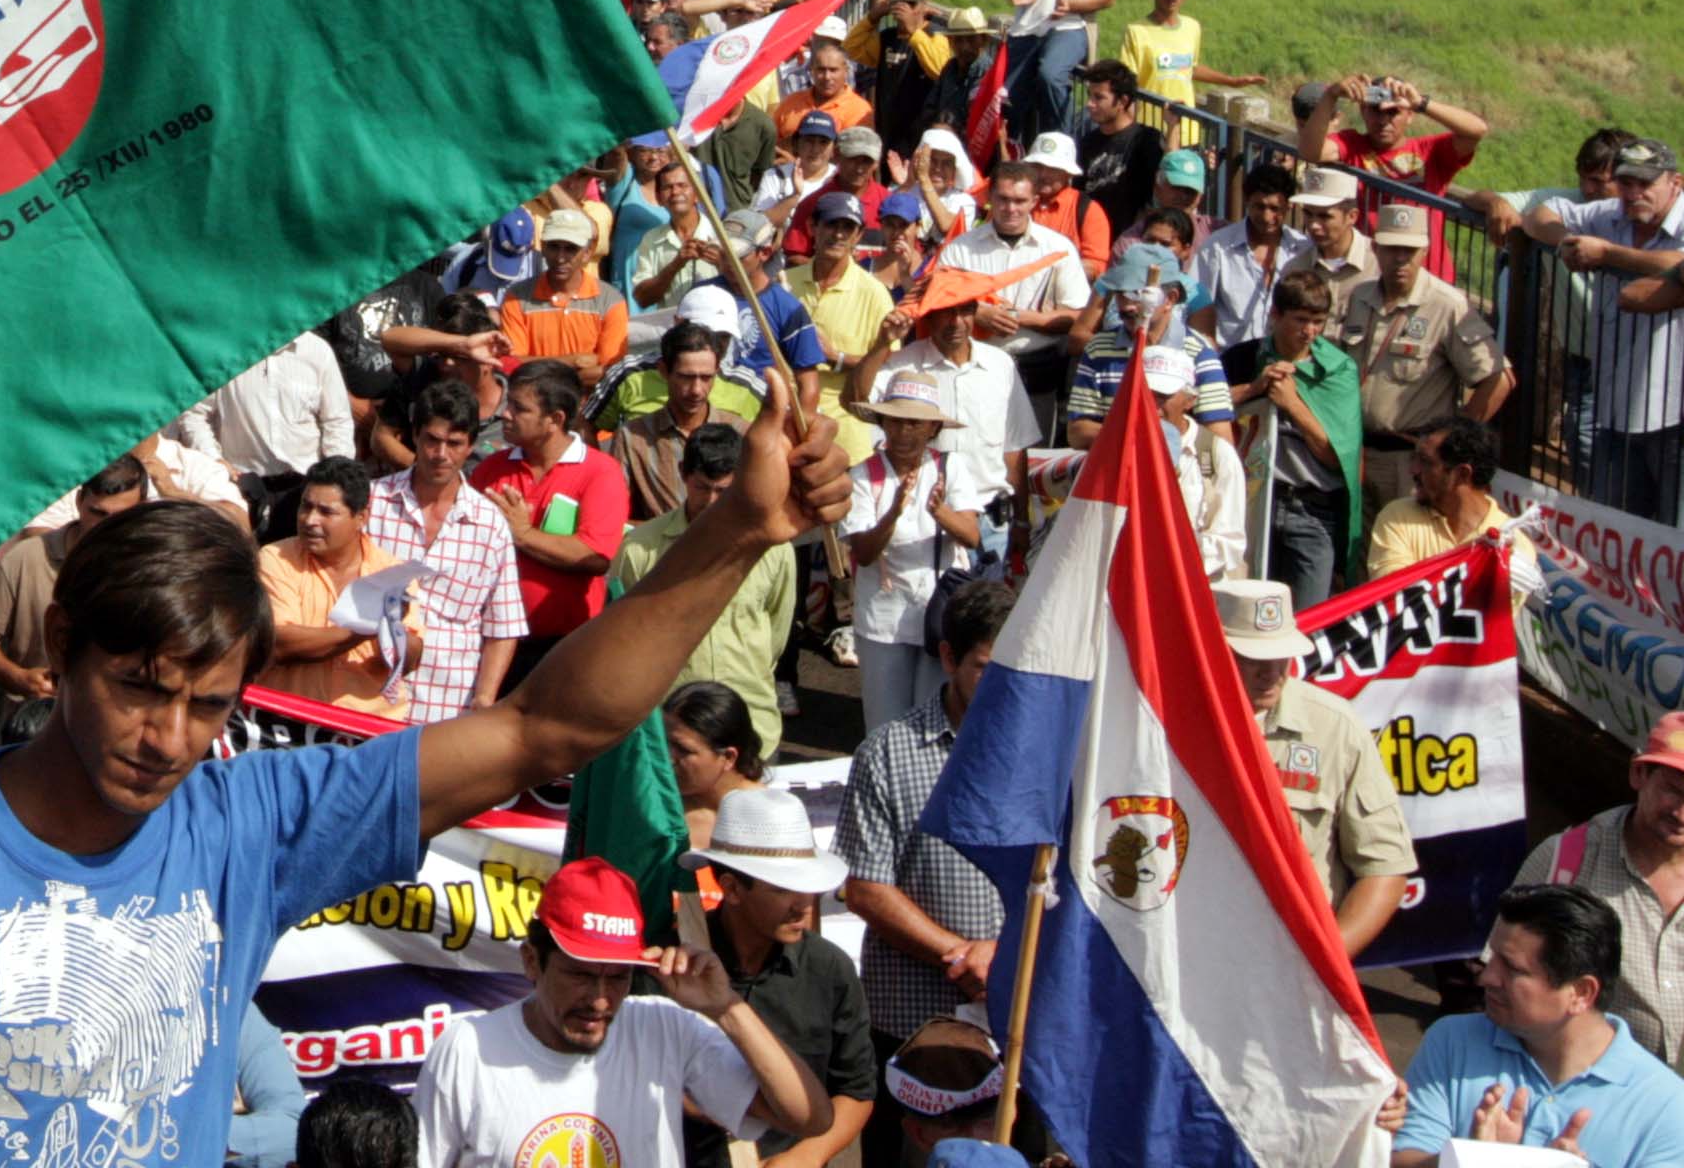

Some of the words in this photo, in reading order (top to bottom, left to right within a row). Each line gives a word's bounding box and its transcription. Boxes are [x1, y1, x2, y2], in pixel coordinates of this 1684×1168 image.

[18, 191, 54, 221] EL
[55, 173, 91, 200] 25
[442, 879, 476, 951] y
[582, 912, 638, 937] STAHL
[563, 1118, 615, 1165] COLONIAL
